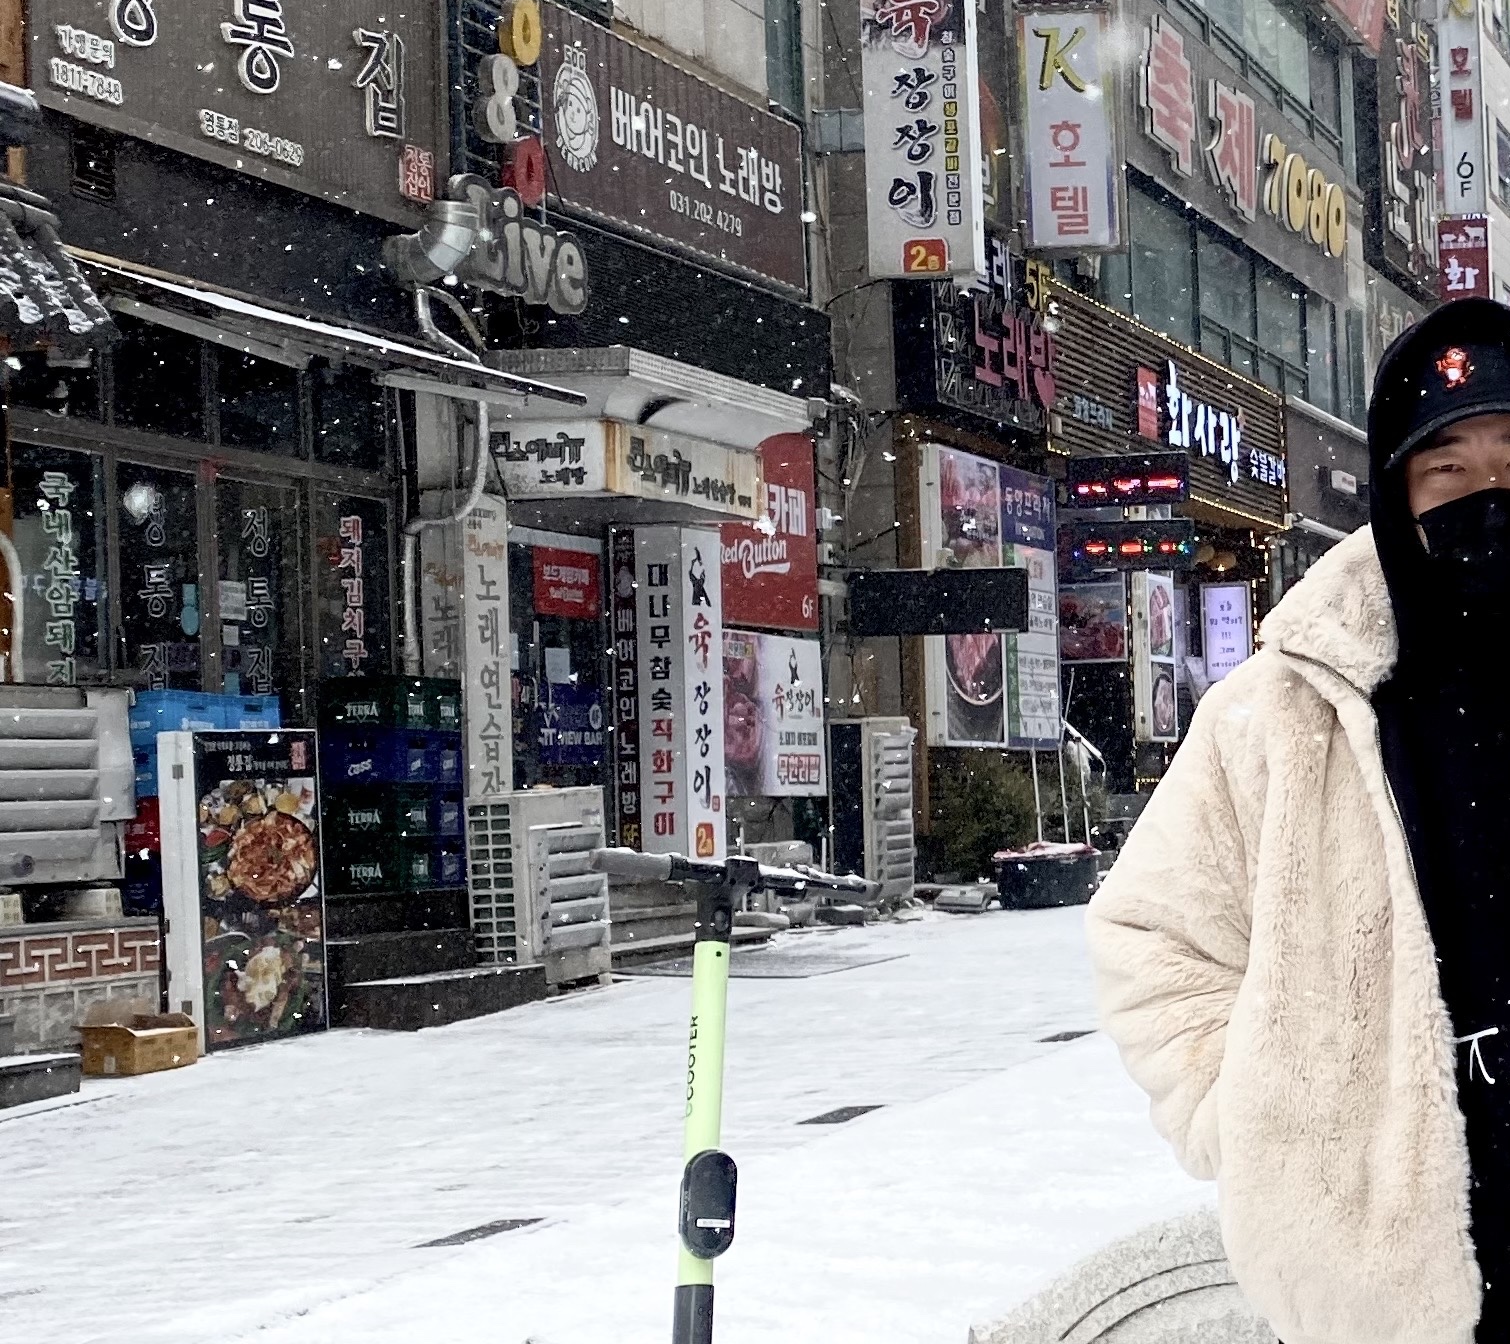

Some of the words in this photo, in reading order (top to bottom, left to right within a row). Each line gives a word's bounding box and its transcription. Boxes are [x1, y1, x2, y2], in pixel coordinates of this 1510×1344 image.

[717, 137, 784, 214] 노래방
[1049, 120, 1089, 236] 호텔
[339, 514, 368, 677] 돼지김치구
[738, 538, 790, 578] Button
[647, 563, 672, 711] 대나무참숯
[688, 613, 712, 810] 육장장이
